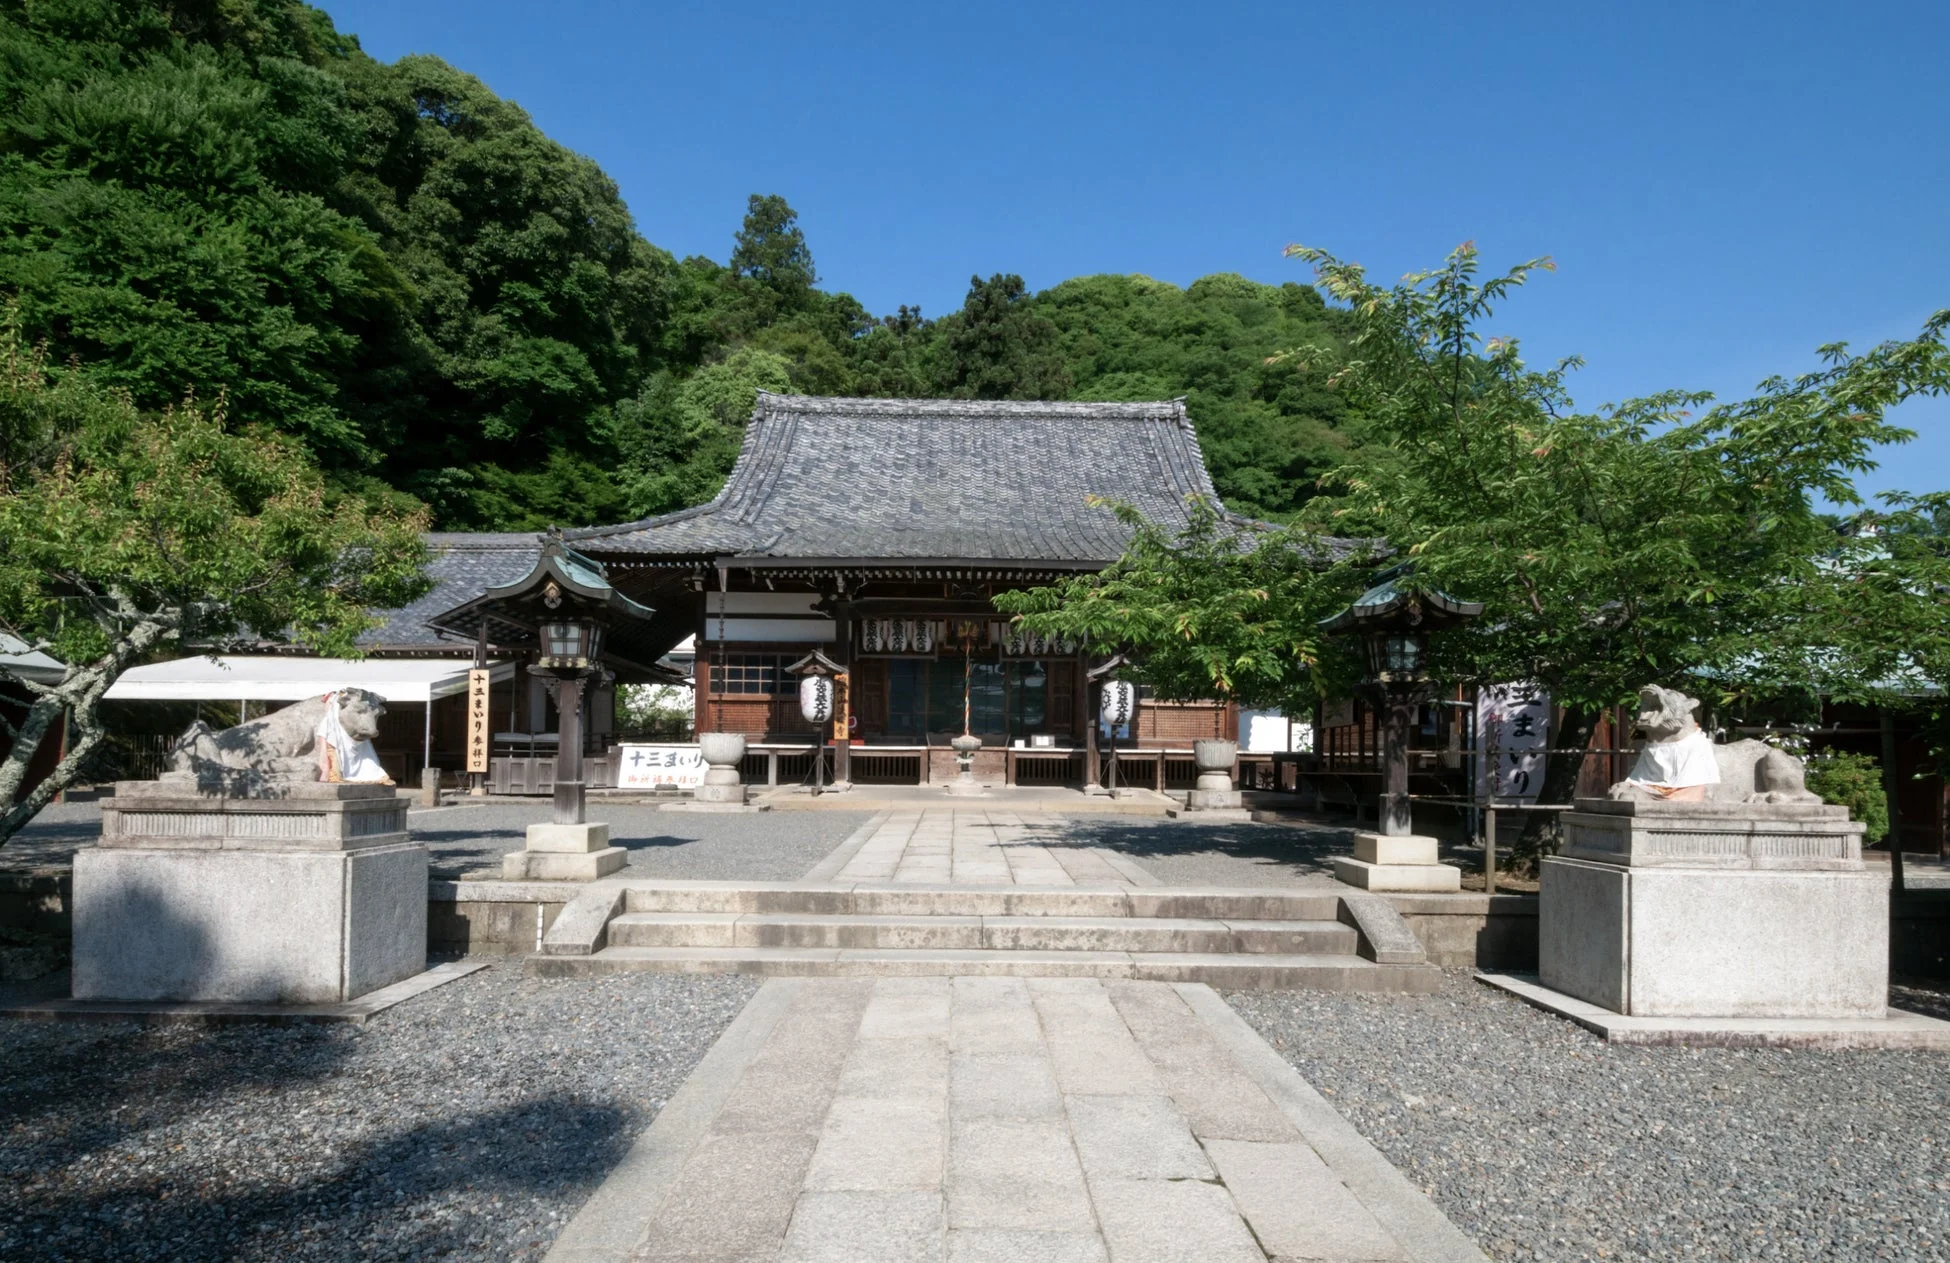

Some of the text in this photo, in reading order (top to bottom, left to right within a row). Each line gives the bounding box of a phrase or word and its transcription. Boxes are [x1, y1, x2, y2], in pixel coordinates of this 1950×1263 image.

[473, 674, 485, 768] 十三まいり参拝口
[629, 750, 704, 768] 十三まいり
